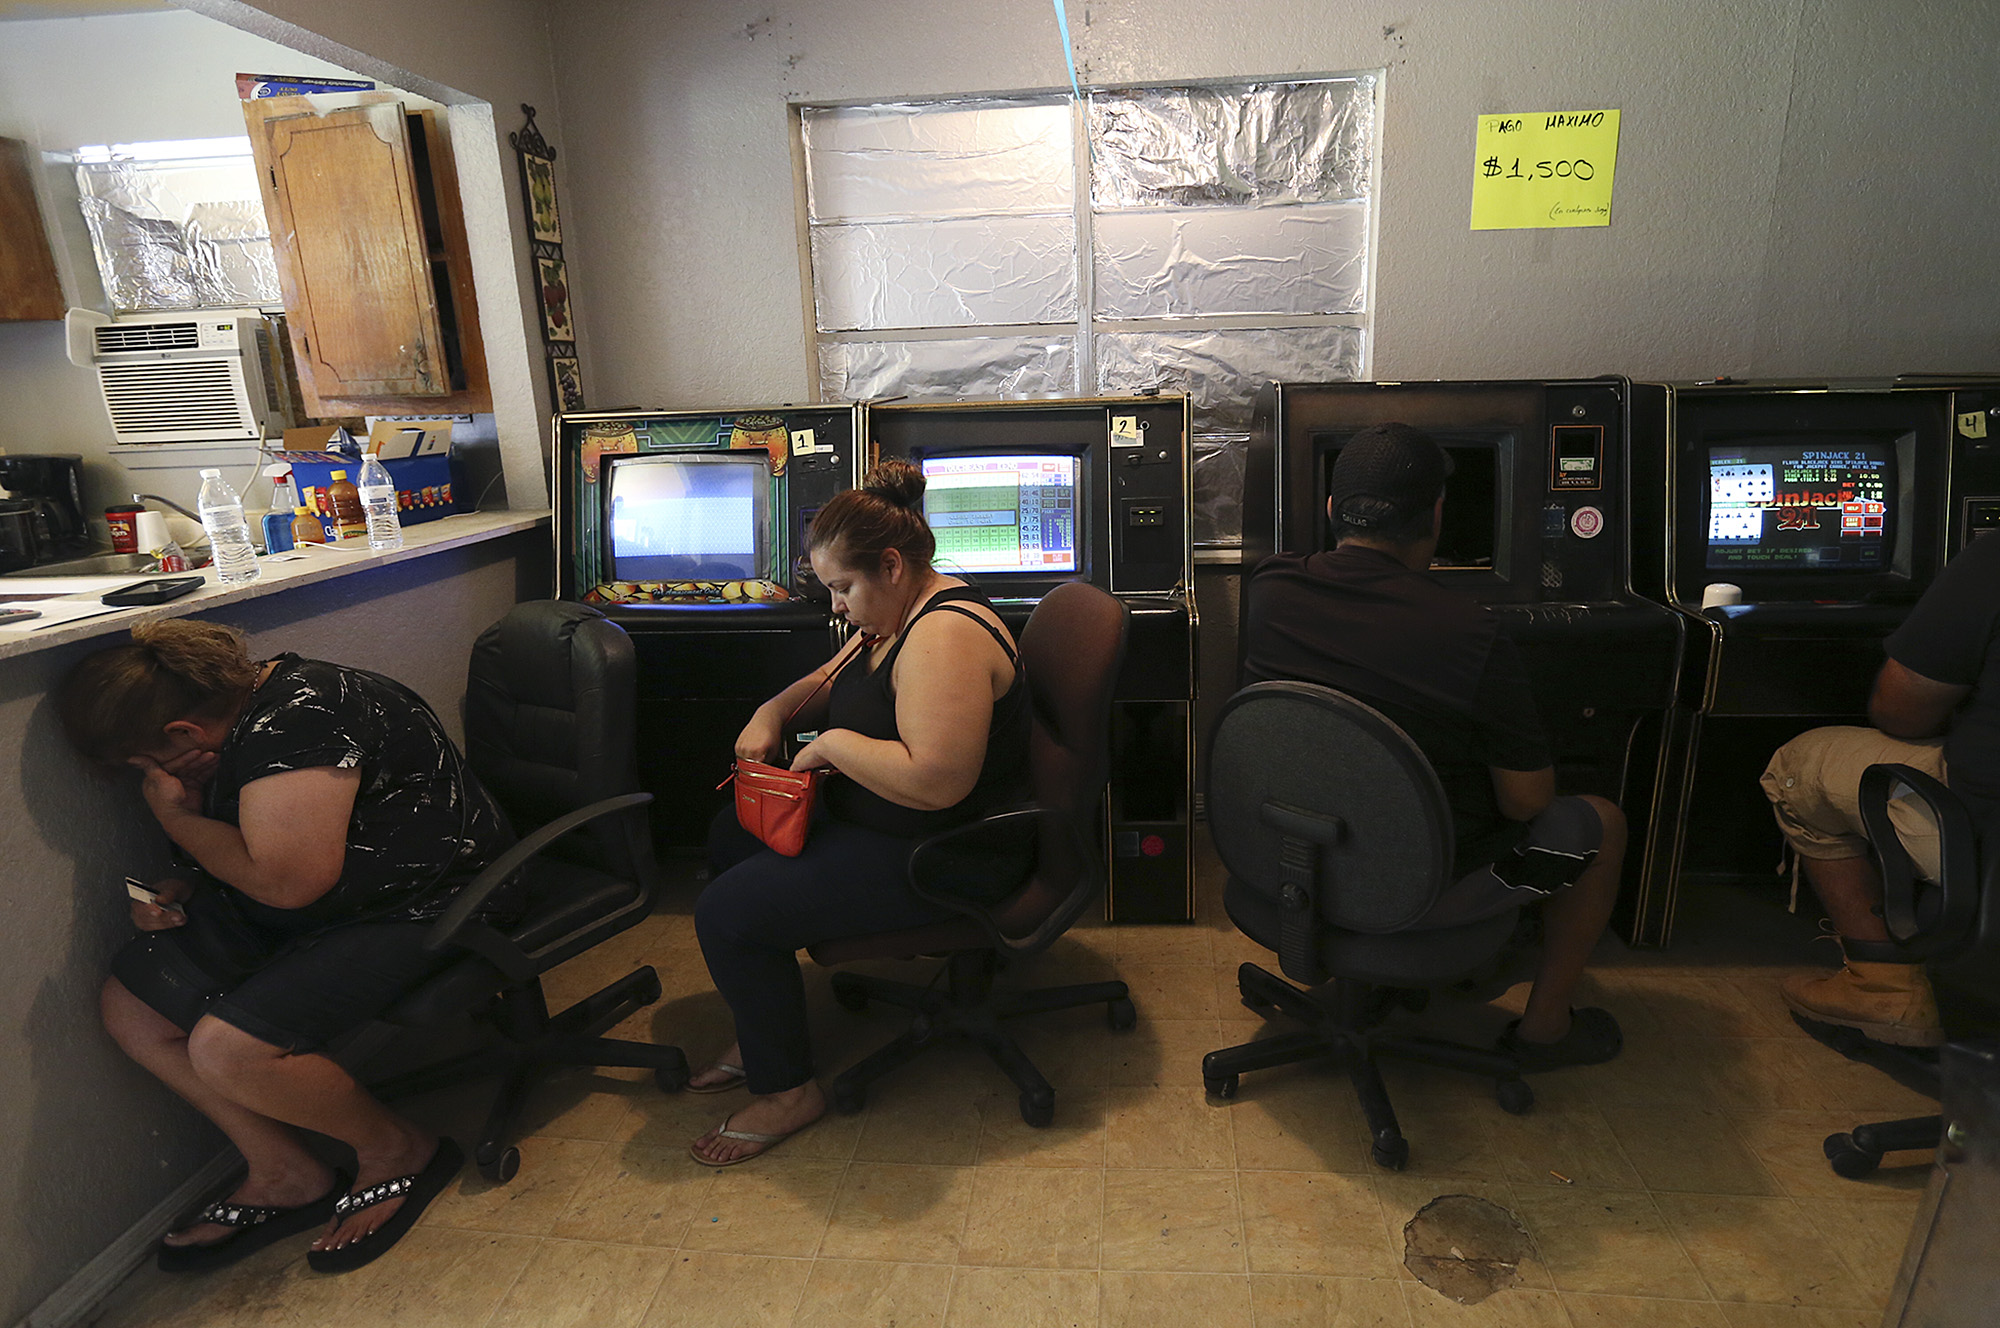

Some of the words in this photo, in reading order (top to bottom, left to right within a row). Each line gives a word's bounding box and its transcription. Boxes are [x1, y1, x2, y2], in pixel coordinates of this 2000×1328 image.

[1486, 119, 1522, 134] PAGO
[1545, 112, 1604, 130] MAXIMO
[1482, 156, 1594, 181] $1,500
[1119, 420, 1131, 434] 2
[1965, 415, 1977, 432] 4
[797, 434, 808, 449] 1
[1802, 452, 1849, 460] SPINJACK
